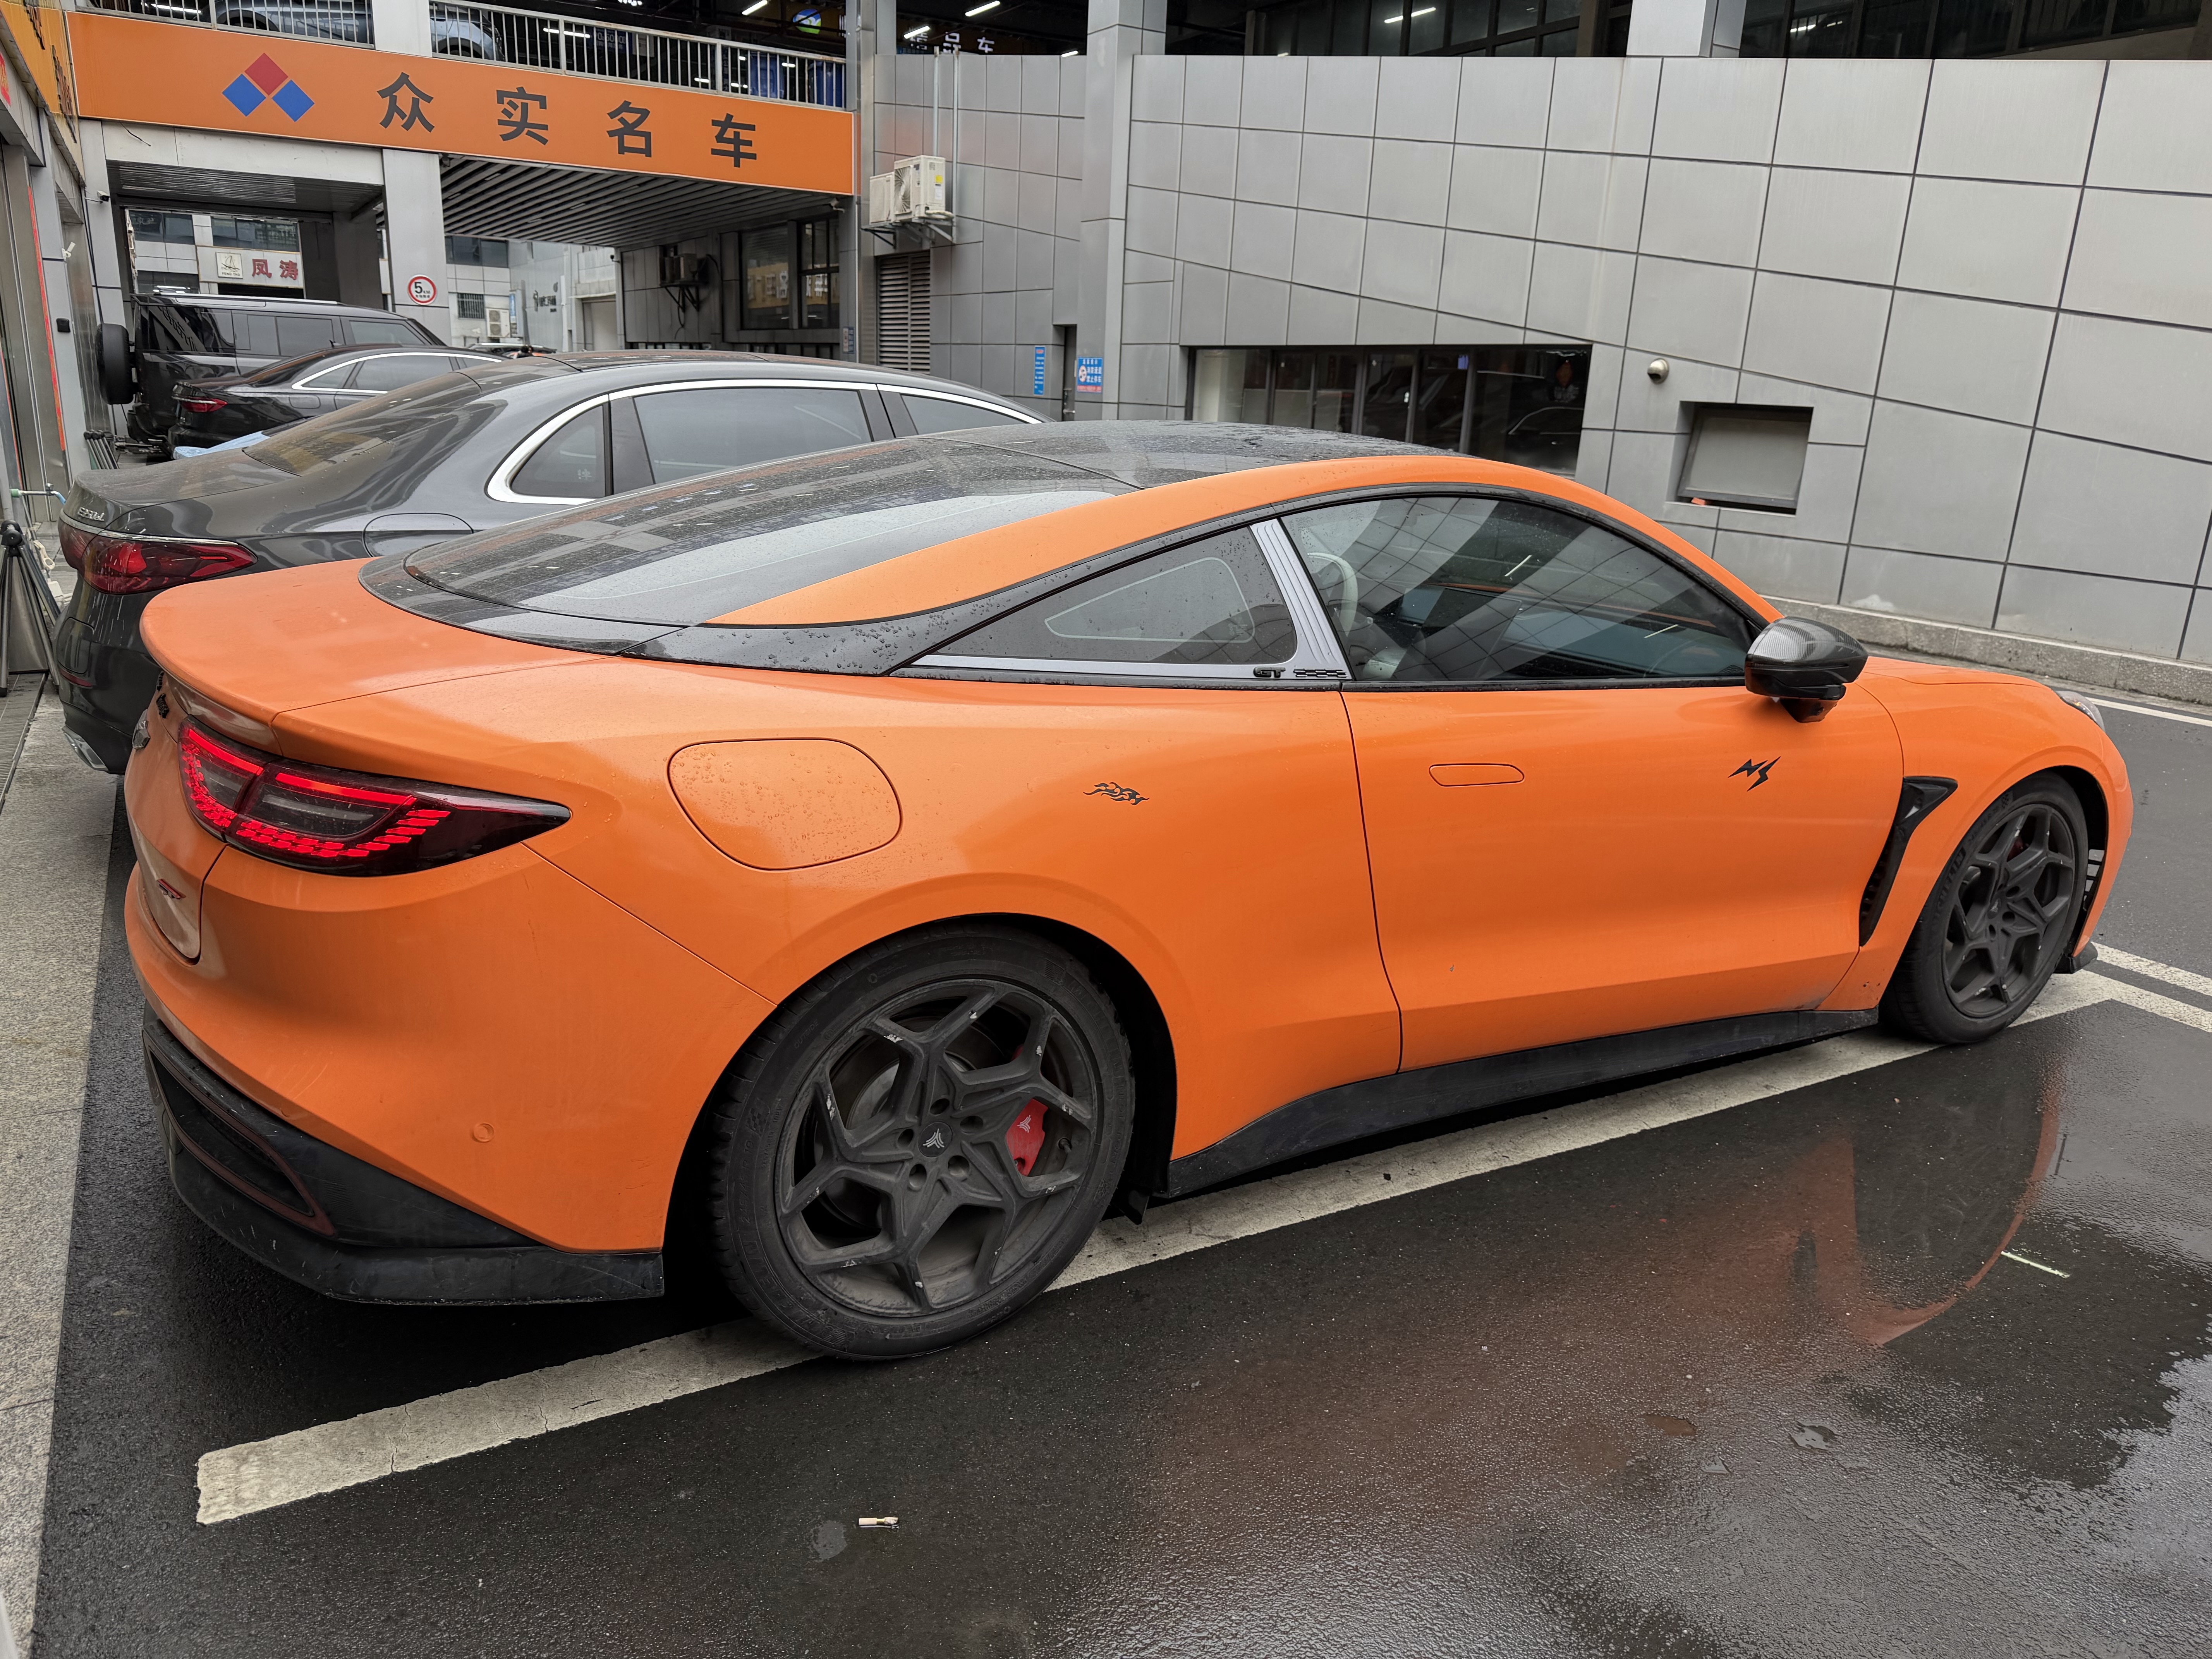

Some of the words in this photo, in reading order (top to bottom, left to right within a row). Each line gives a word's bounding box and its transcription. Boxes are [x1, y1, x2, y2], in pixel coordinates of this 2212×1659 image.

[377, 72, 757, 168] 众实名车
[252, 259, 298, 280] 凤涛
[414, 282, 422, 294] 5
[1253, 666, 1286, 678] GT
